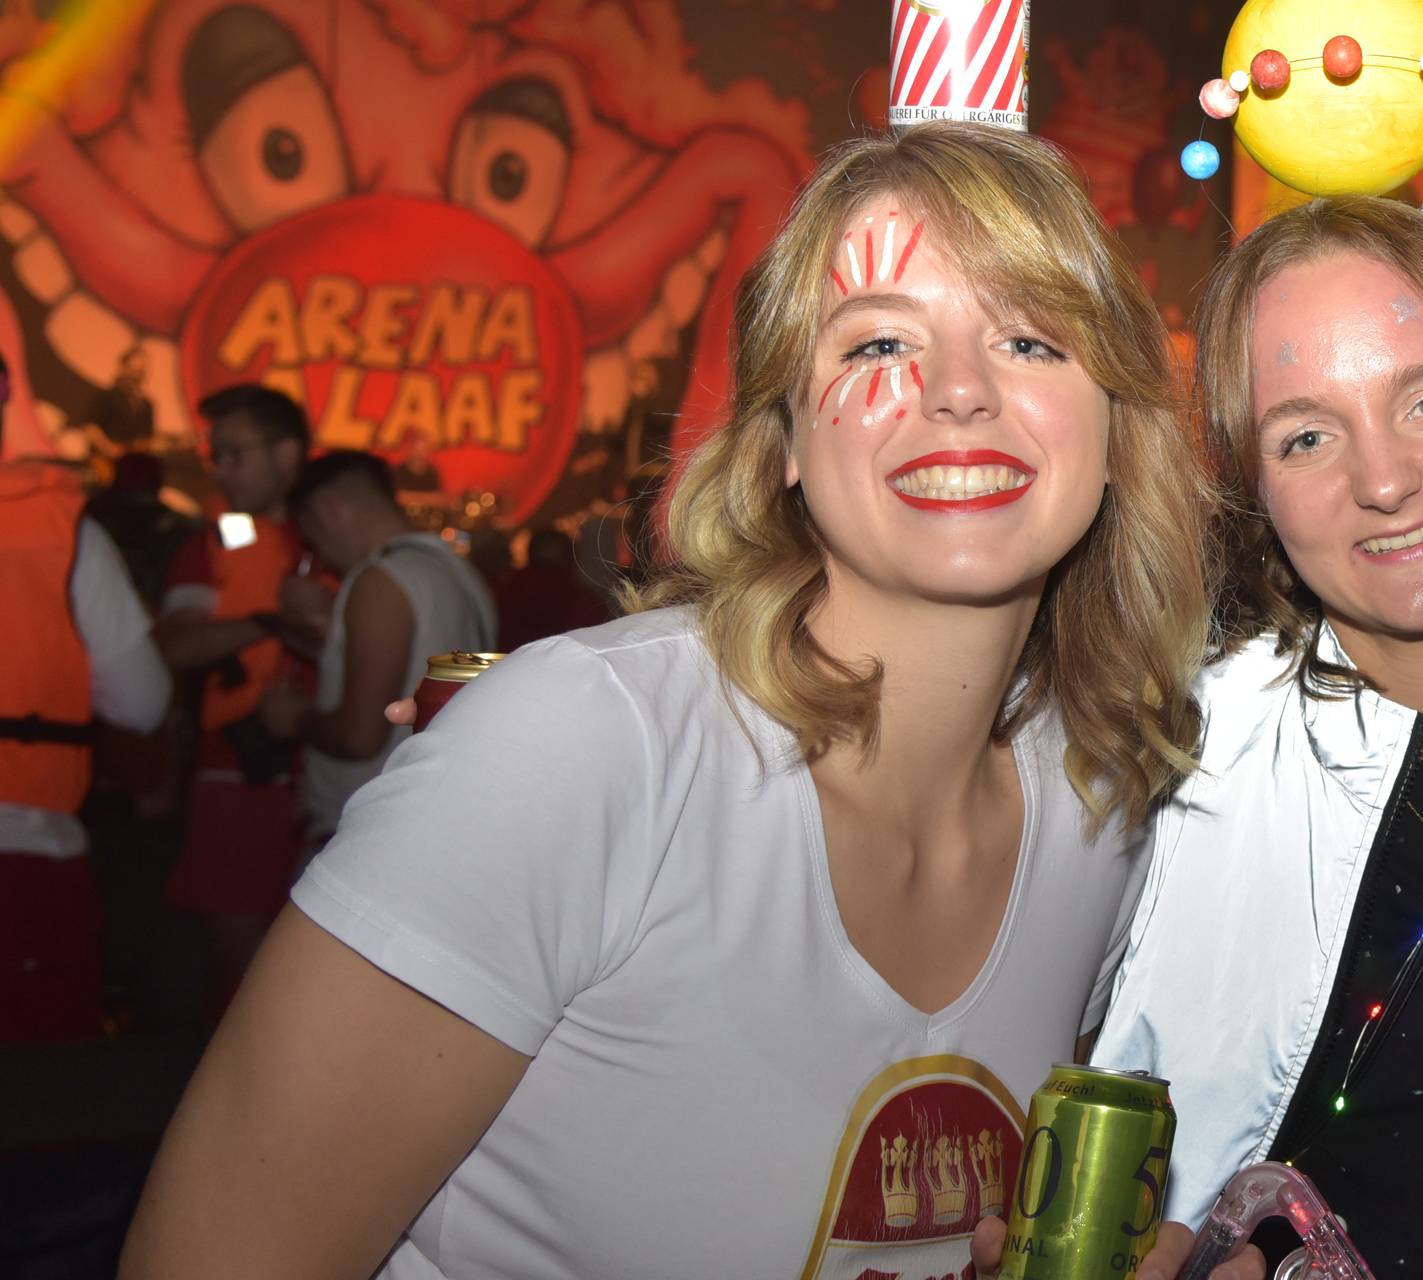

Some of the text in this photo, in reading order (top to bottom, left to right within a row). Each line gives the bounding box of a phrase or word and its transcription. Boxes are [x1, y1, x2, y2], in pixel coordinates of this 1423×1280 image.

[915, 105, 938, 120] FÜR
[942, 107, 1021, 125] OERGÄRIGES
[218, 273, 538, 369] ARENA
[1056, 1080, 1096, 1097] Euch!
[1018, 1126, 1063, 1219] 0
[1120, 1146, 1168, 1237] 5
[1003, 1233, 1049, 1258] INAL
